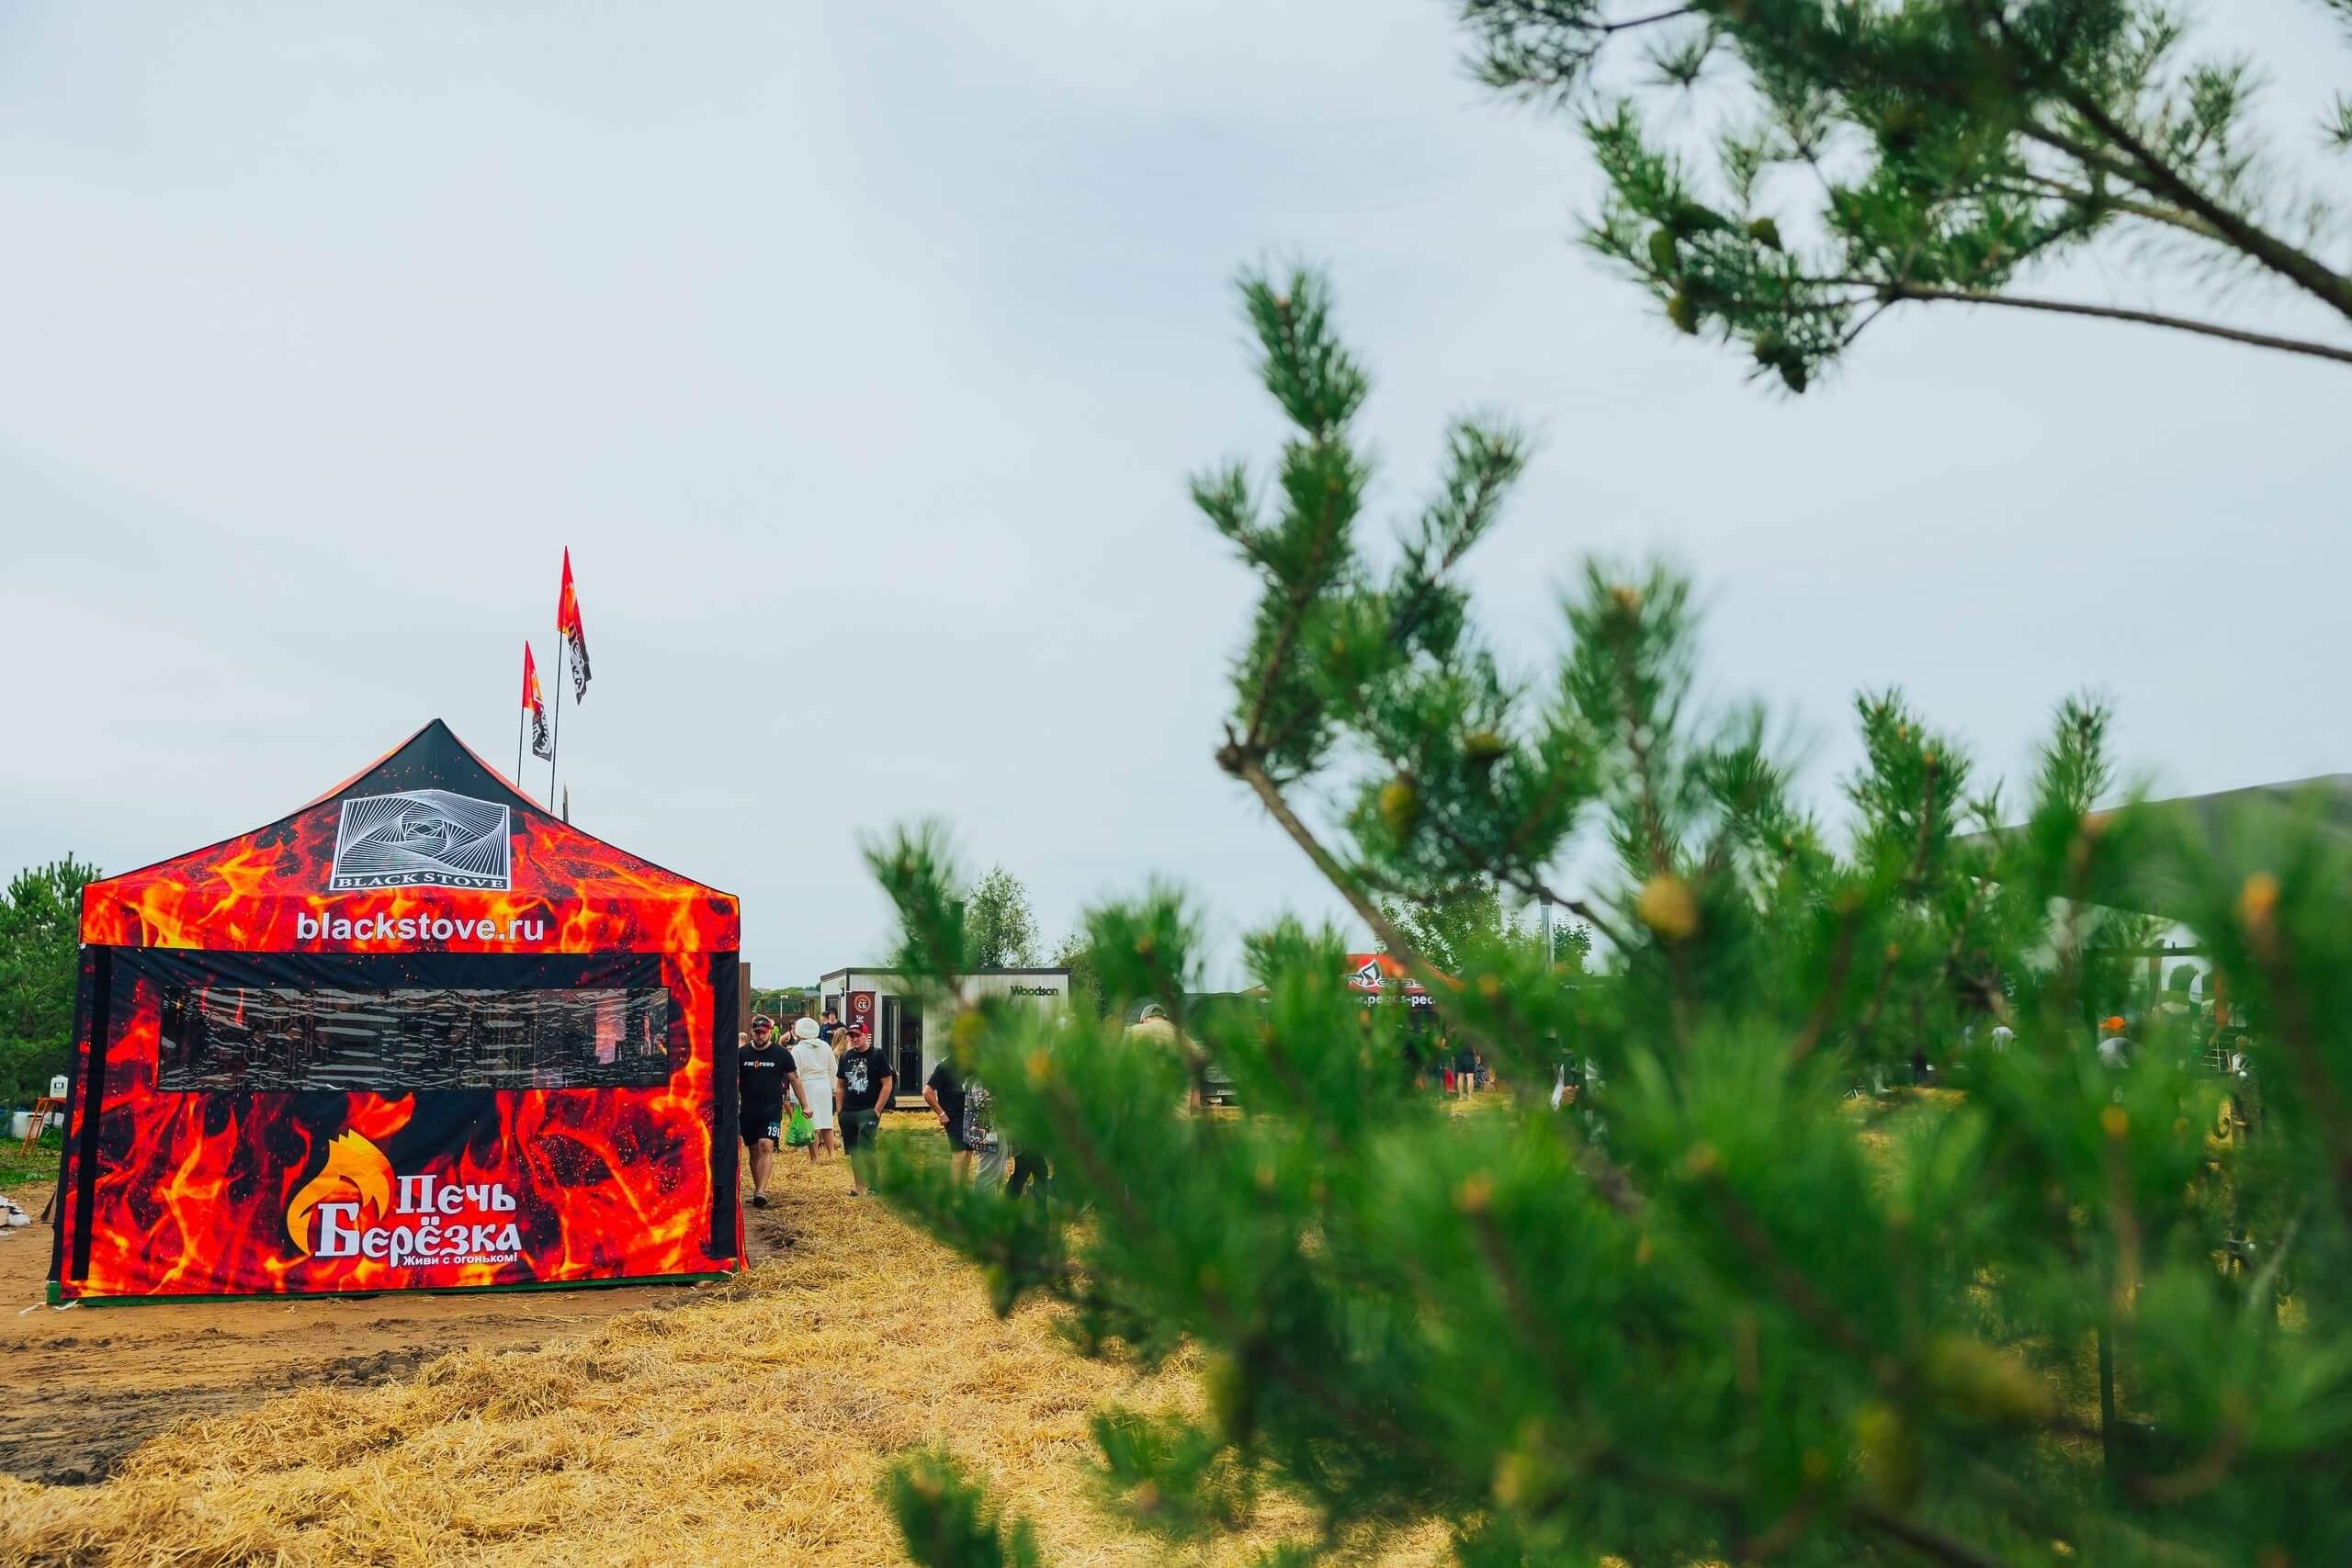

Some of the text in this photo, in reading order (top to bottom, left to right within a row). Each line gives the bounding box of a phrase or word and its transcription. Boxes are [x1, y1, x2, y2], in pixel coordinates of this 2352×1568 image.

[336, 872, 504, 889] BLACK STOVE
[297, 911, 544, 941] blackstove.ru
[1010, 985, 1059, 997] Woodson
[395, 1174, 516, 1214] Печь
[315, 1202, 522, 1268] Берёзка
[402, 1253, 518, 1266] Живи с огоньком!
